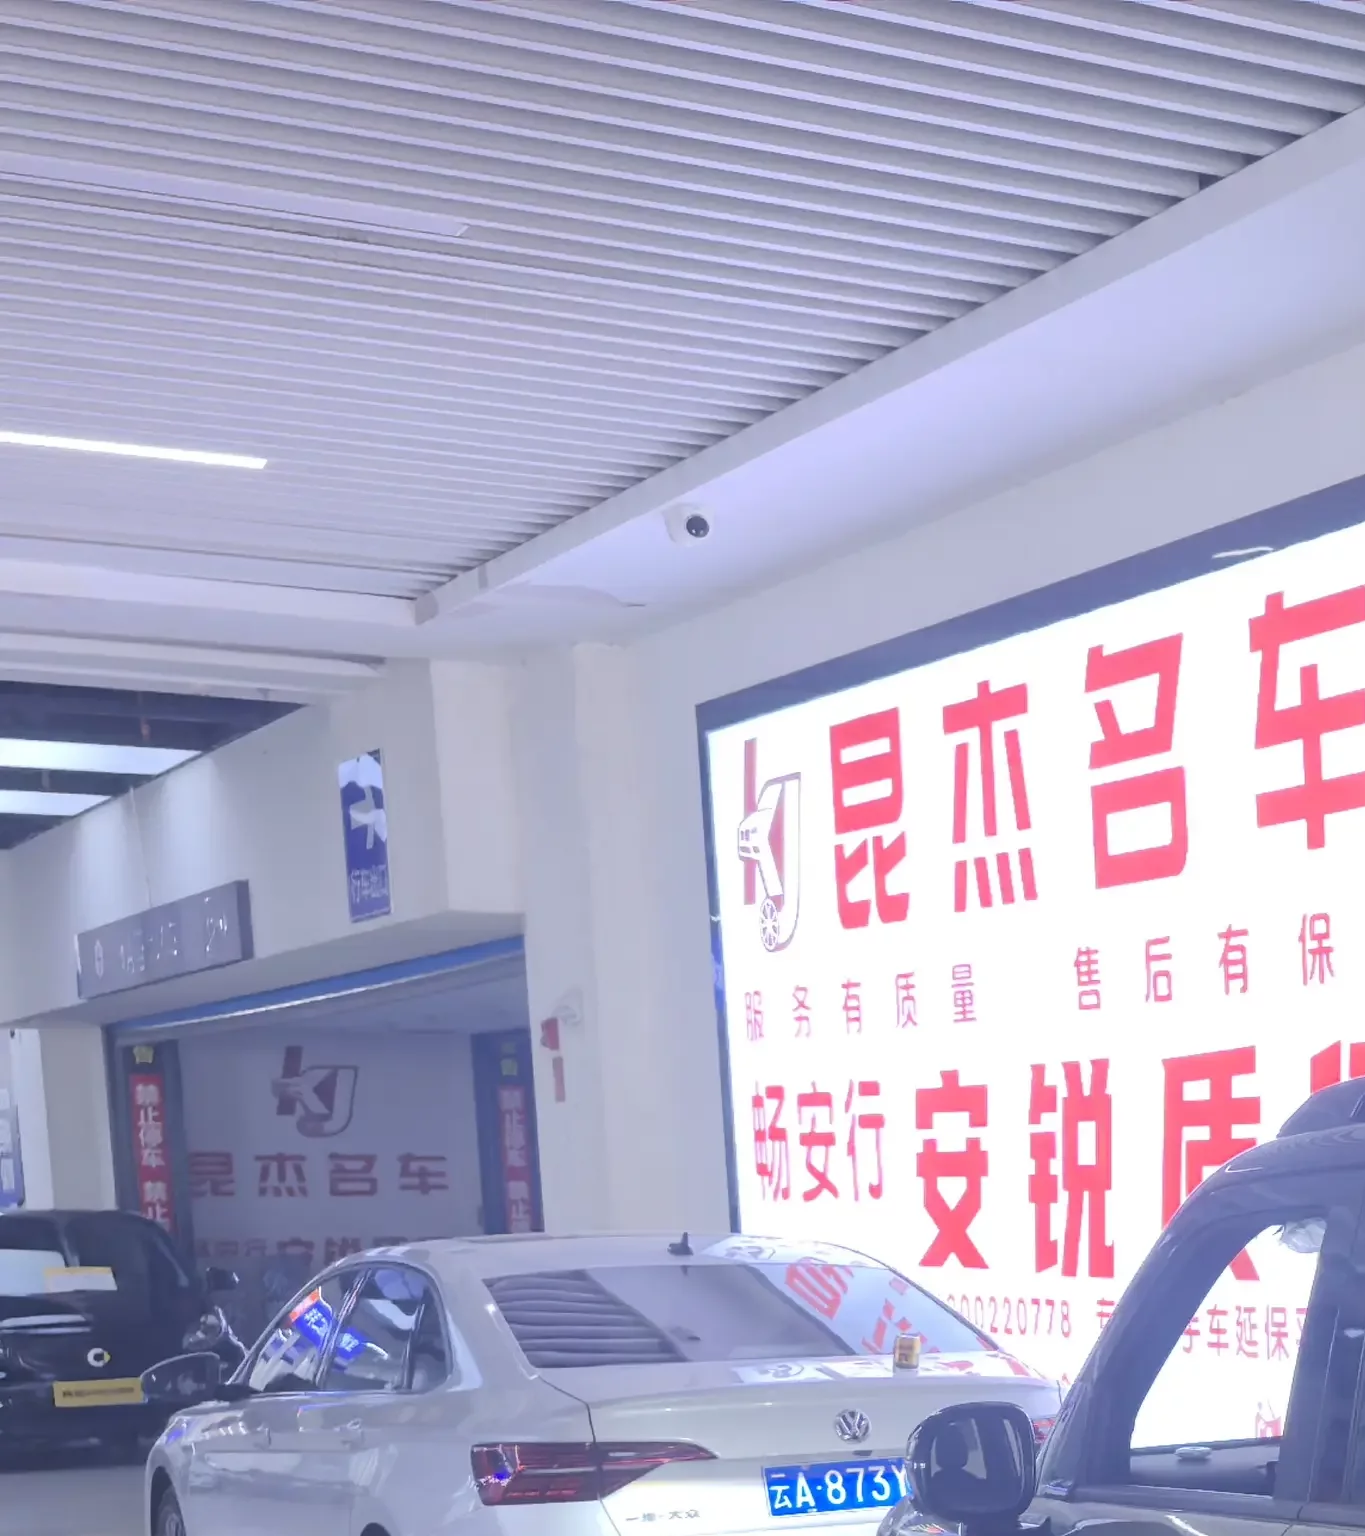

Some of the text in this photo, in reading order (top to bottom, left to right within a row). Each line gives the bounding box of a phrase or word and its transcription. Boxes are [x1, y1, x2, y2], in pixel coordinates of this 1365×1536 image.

[745, 963, 977, 1042] 服务有质量
[187, 1152, 450, 1198] 昆杰名车
[752, 1079, 886, 1202] 畅安行
